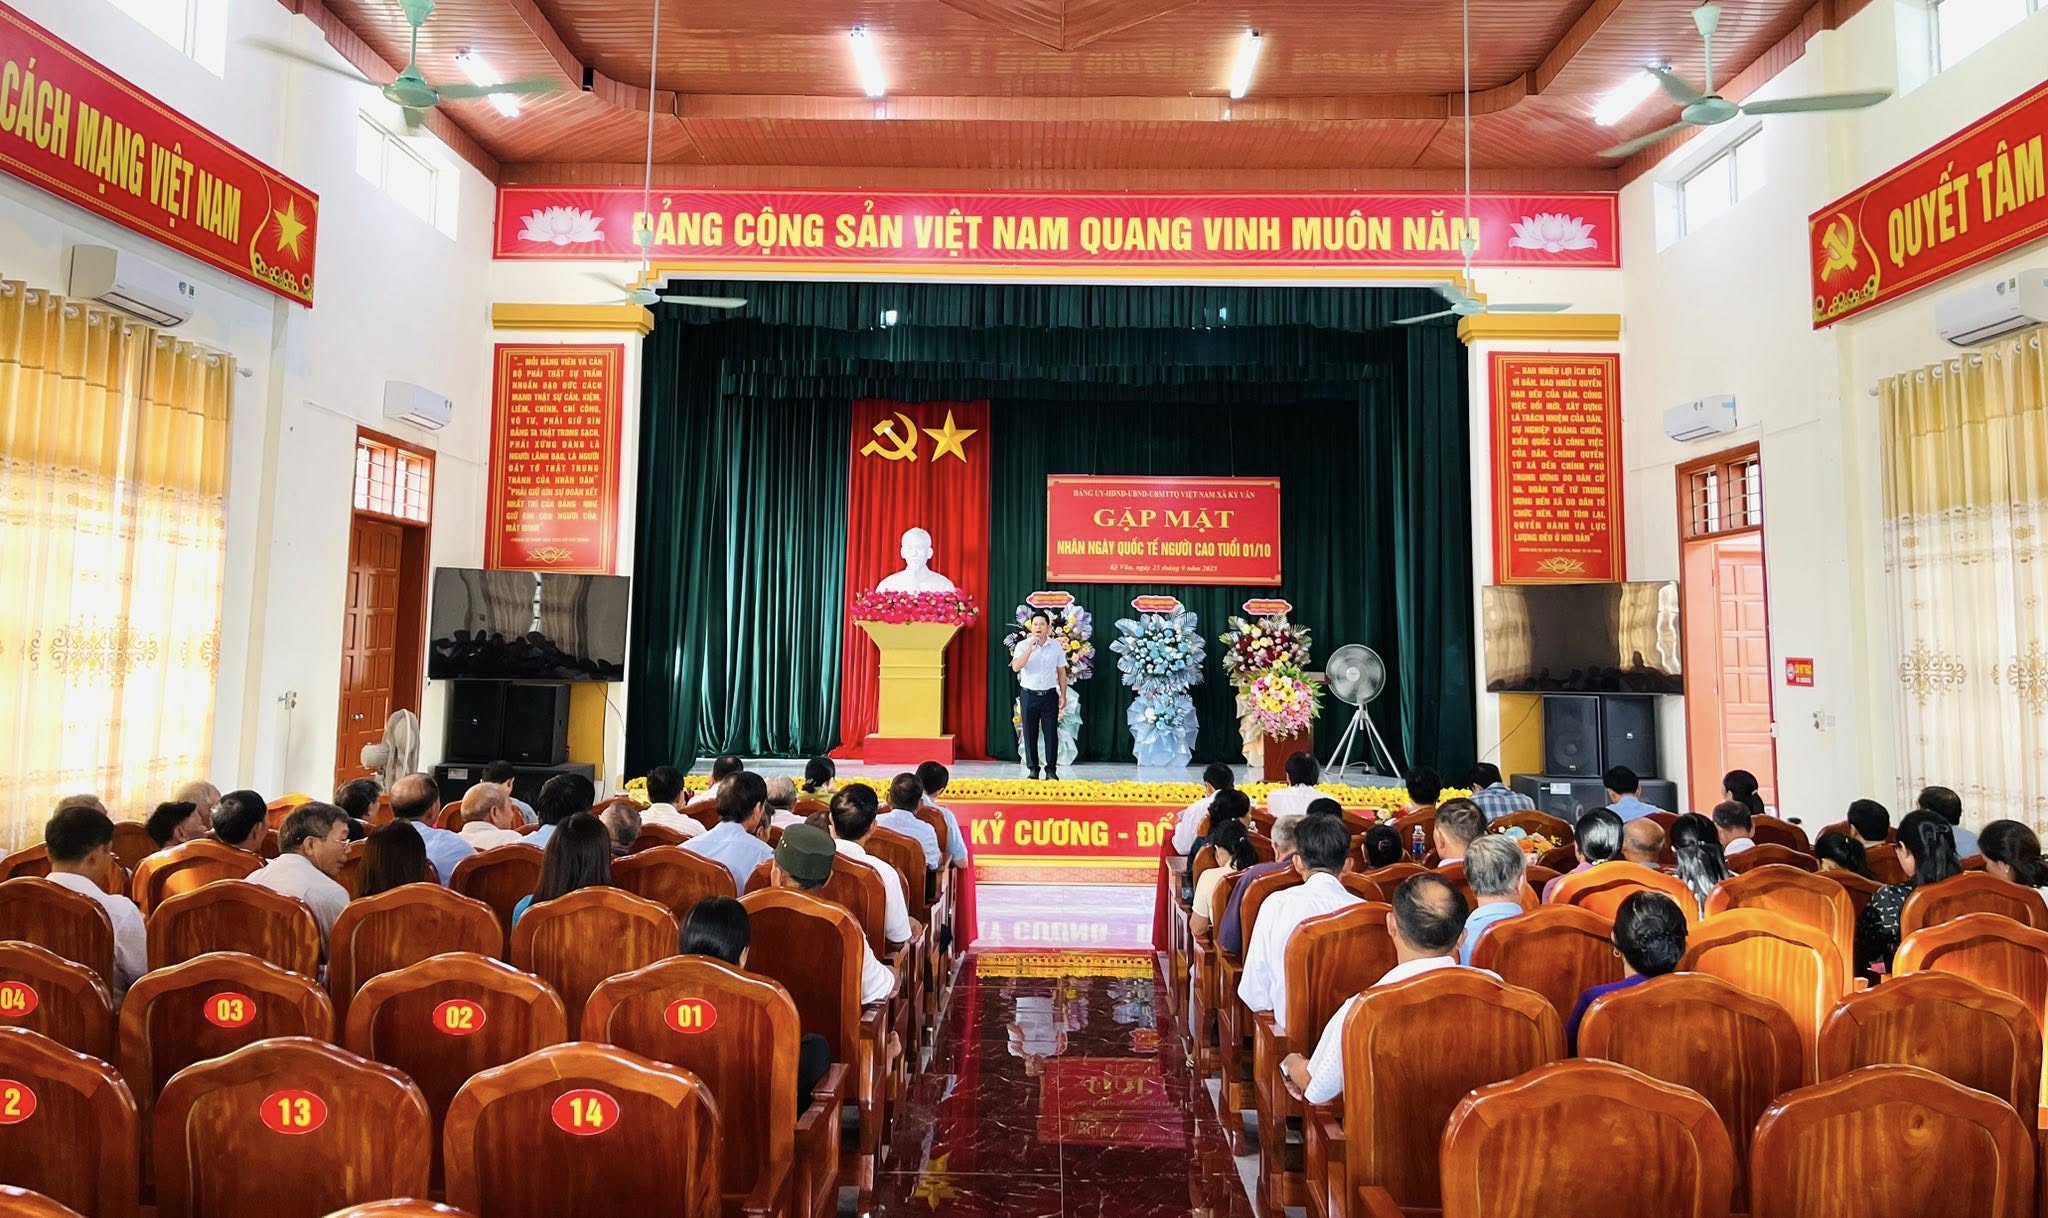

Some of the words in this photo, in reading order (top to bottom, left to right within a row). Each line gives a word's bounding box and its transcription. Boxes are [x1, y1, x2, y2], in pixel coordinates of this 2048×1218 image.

[0, 57, 71, 159] CÁCH
[74, 101, 145, 197] MẠNG
[151, 142, 194, 227] VIỆT
[197, 169, 241, 244] NAM
[1888, 161, 1969, 268] QUYẾT
[1976, 135, 2045, 222] TÂM
[633, 198, 722, 246] ĐẢNG
[734, 206, 823, 254] CỘNG
[836, 200, 902, 248] SẢN
[915, 209, 982, 256] VIỆT
[994, 216, 1068, 250] NAM
[1081, 217, 1192, 254] QUANG
[1203, 217, 1279, 250] VINH
[1293, 210, 1391, 251] MUÔN
[1403, 210, 1480, 251] NĂM
[1199, 489, 1215, 499] NAM
[1094, 507, 1157, 532] GẶP
[1164, 507, 1234, 532] MẶT
[1057, 538, 1085, 555] NHÂN
[1088, 539, 1114, 555] NGÀY
[1118, 536, 1144, 556] QUỐC
[1147, 538, 1159, 556] TẾ
[1161, 539, 1191, 556] NGƯỜI
[1195, 543, 1214, 557] CAO
[1218, 537, 1240, 557] TUỔI
[1243, 543, 1271, 558] 01/10
[1202, 563, 1217, 572] 2025
[971, 811, 1005, 844] KỶ
[1014, 818, 1108, 846] CƯƠNG
[1136, 812, 1174, 847] ĐỔ
[0, 987, 26, 1010] 04
[217, 998, 244, 1022] 03
[445, 1005, 473, 1029] 02
[677, 1004, 702, 1028] 01
[4, 1089, 21, 1116] 2
[278, 1098, 311, 1126] 13
[569, 1098, 603, 1127] 14
